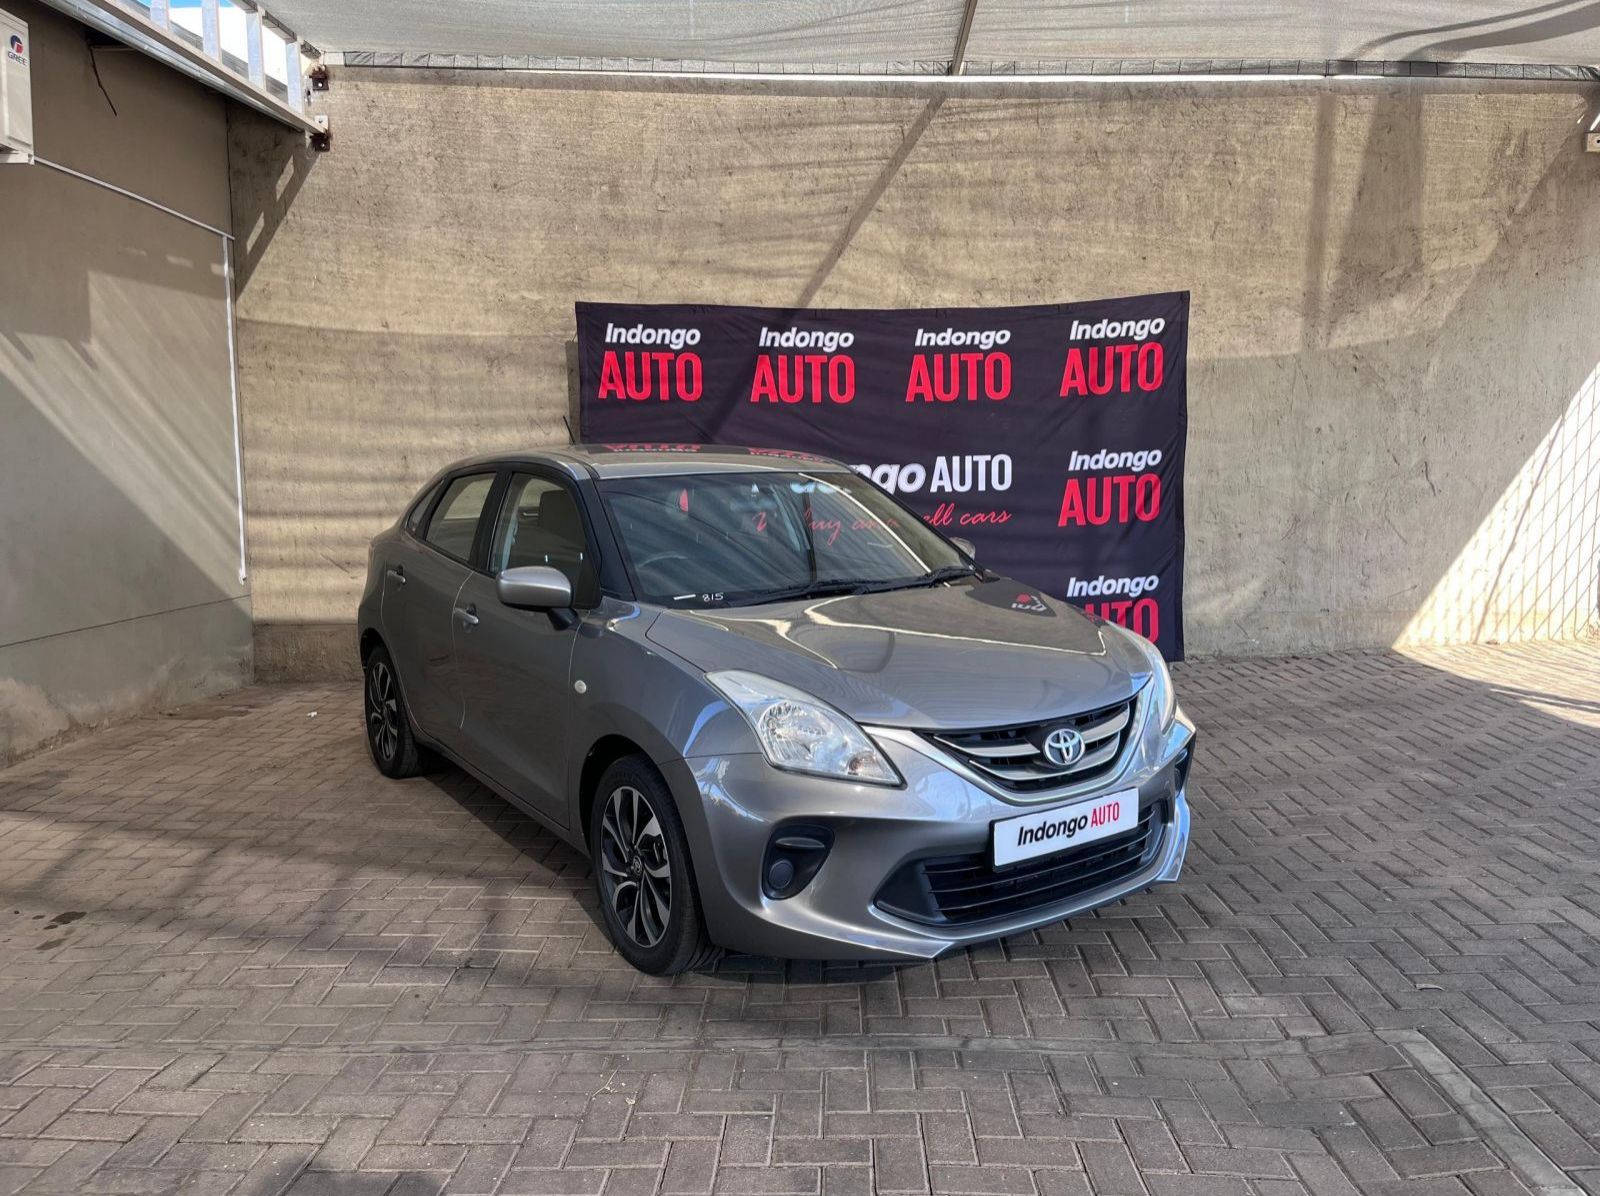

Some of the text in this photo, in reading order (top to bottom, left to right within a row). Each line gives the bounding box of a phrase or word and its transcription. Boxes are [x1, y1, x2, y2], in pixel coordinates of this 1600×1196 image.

[8, 50, 28, 66] GREE
[605, 323, 700, 350] Indongo
[759, 327, 854, 353] Indongo
[914, 328, 1011, 350] Indongo
[1069, 317, 1165, 341] Indongo
[598, 350, 703, 402] AUTO
[750, 353, 856, 404] AUTO
[905, 351, 1012, 403] AUTO
[1059, 341, 1164, 397] AUTO
[929, 453, 1012, 493] AUTO
[1068, 448, 1162, 472] Indongo
[1058, 473, 1162, 527] AUTO
[960, 510, 1012, 526] cars
[702, 592, 724, 602] 815
[1066, 575, 1159, 598] Indongo
[1017, 802, 1120, 847] Indongo AUTO
